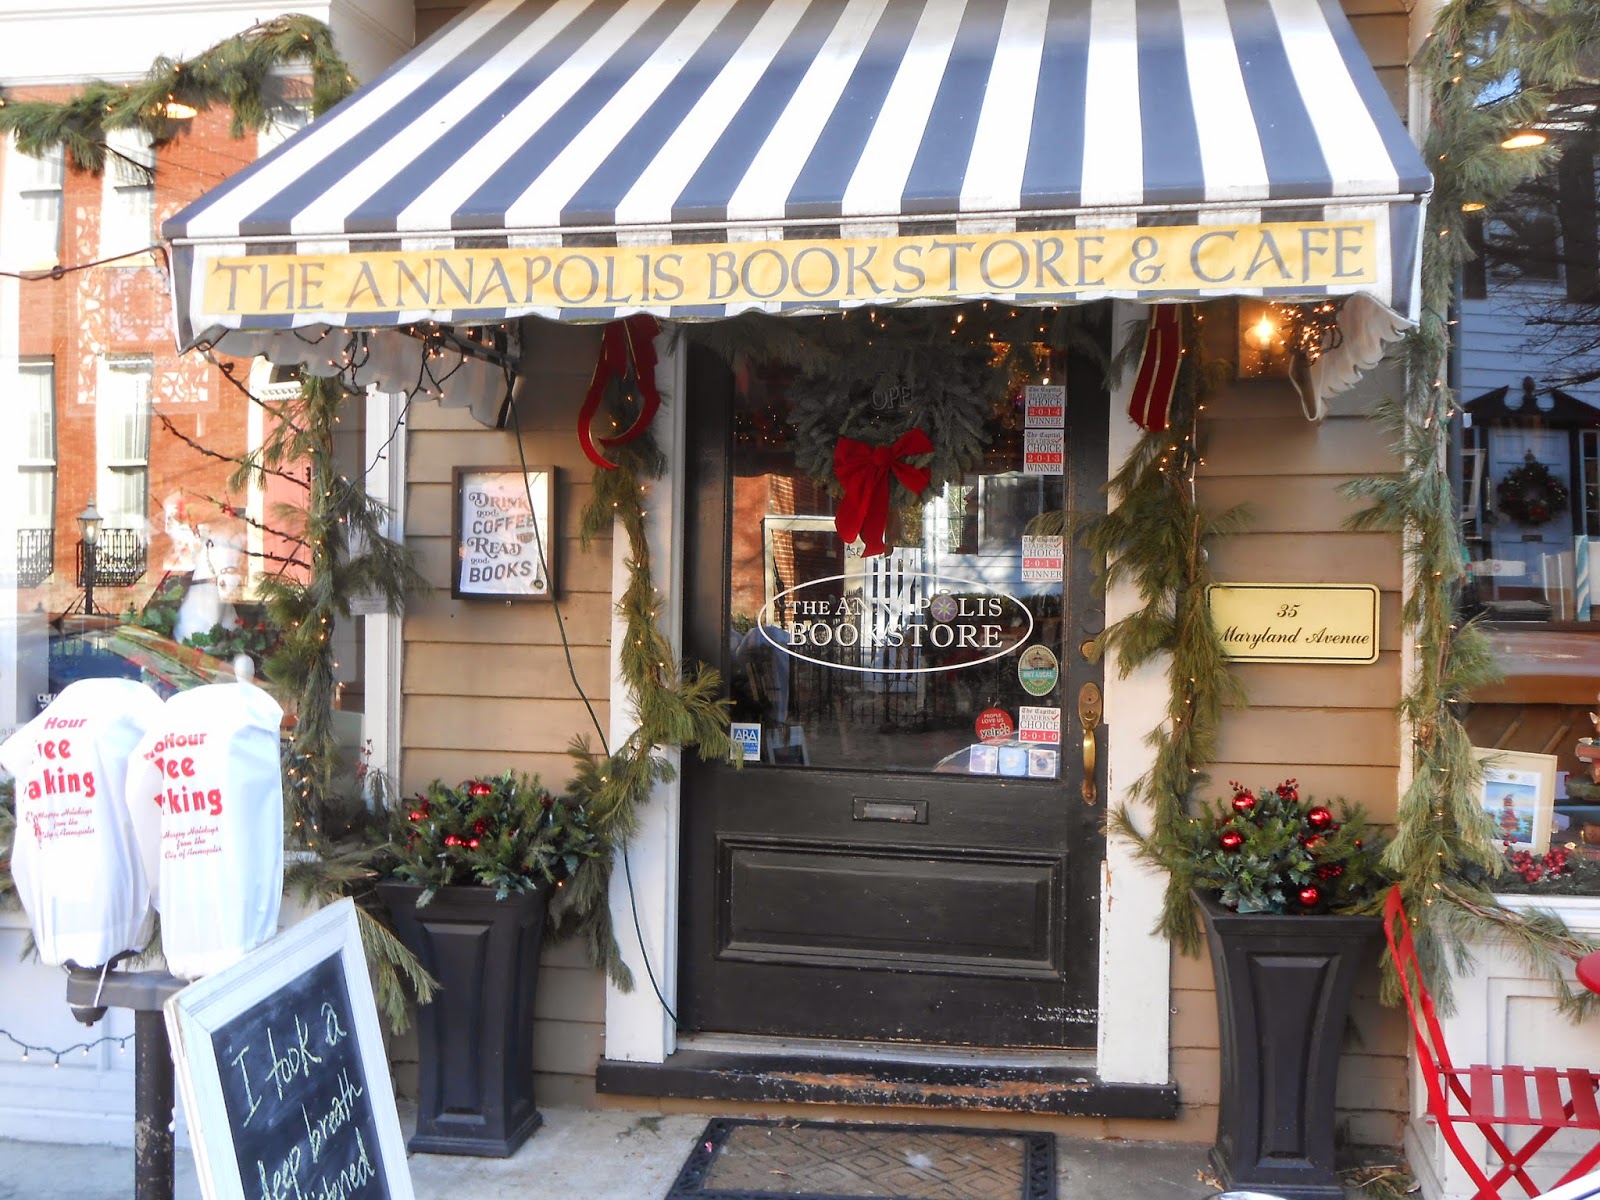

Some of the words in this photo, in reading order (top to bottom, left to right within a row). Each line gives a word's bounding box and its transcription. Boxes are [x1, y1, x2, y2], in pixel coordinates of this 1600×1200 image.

[212, 260, 324, 310] THE
[345, 252, 687, 308] ANNAPOLIS
[707, 236, 1105, 299] BOOKSTORE
[1128, 236, 1165, 283] &
[1189, 226, 1365, 284] CAFE
[870, 386, 911, 410] OPE
[1028, 398, 1062, 407] CHOICE
[1027, 444, 1061, 453] CHOICE
[1027, 464, 1060, 472] WINNER
[473, 514, 534, 535] COFFEE
[467, 537, 522, 559] READ
[1023, 549, 1062, 557] CHOICE
[469, 561, 532, 583] BOOKS
[1023, 570, 1063, 578] WINNER
[790, 600, 831, 615] THE
[1277, 604, 1300, 618] 35
[787, 622, 1003, 648] BOOKSTORE
[1219, 626, 1302, 649] Maryland
[1305, 627, 1370, 644] Avenue
[44, 717, 88, 730] Hour
[981, 727, 1001, 738] yelp
[1020, 720, 1059, 730] CHOICE
[165, 733, 207, 749] Hour
[735, 729, 758, 740] ABA
[37, 739, 71, 760] ee
[27, 766, 96, 801] aking
[154, 785, 223, 816] king
[231, 1045, 262, 1128] I
[265, 1014, 322, 1100] took
[321, 1002, 347, 1046] a
[302, 1067, 363, 1163] breath
